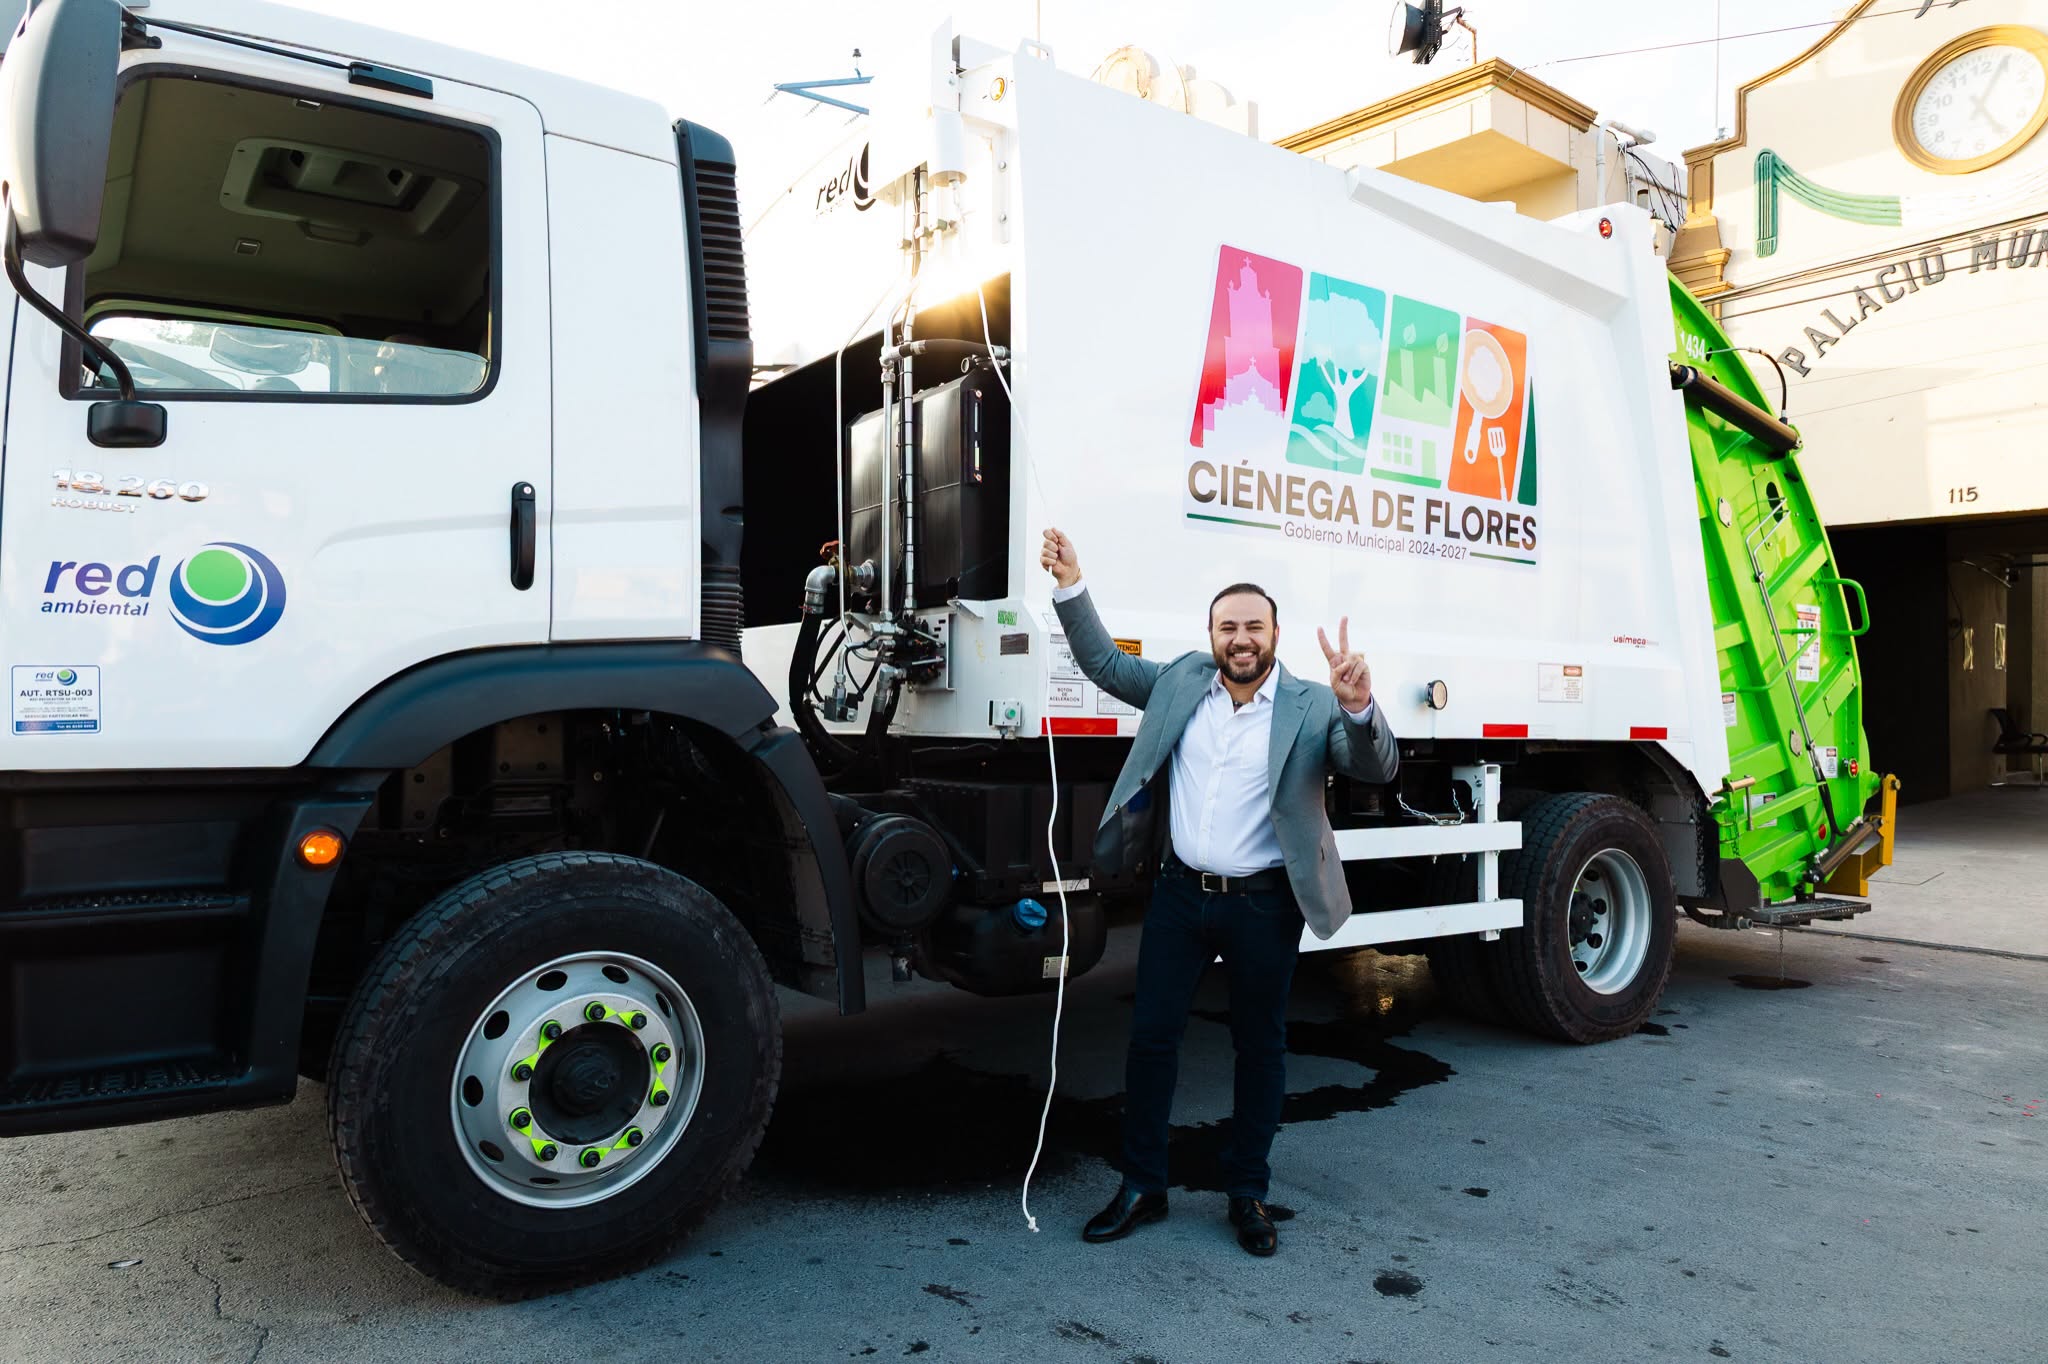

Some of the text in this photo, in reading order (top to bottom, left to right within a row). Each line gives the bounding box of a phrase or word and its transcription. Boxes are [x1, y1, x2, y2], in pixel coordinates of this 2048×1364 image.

[1777, 247, 1946, 378] PALACIO
[52, 468, 209, 502] 18.260
[1949, 486, 1978, 504] 115
[51, 497, 140, 514] ROBUST
[1188, 459, 1537, 551] CIÉNEGA DE FLORES
[1284, 521, 1467, 560] Gobierno Municipal 2024-2027
[44, 555, 161, 598] red
[41, 600, 149, 616] ambiental
[1117, 643, 1139, 652] TENCIA
[35, 671, 54, 679] red
[20, 689, 93, 697] AUT. RTSU-003
